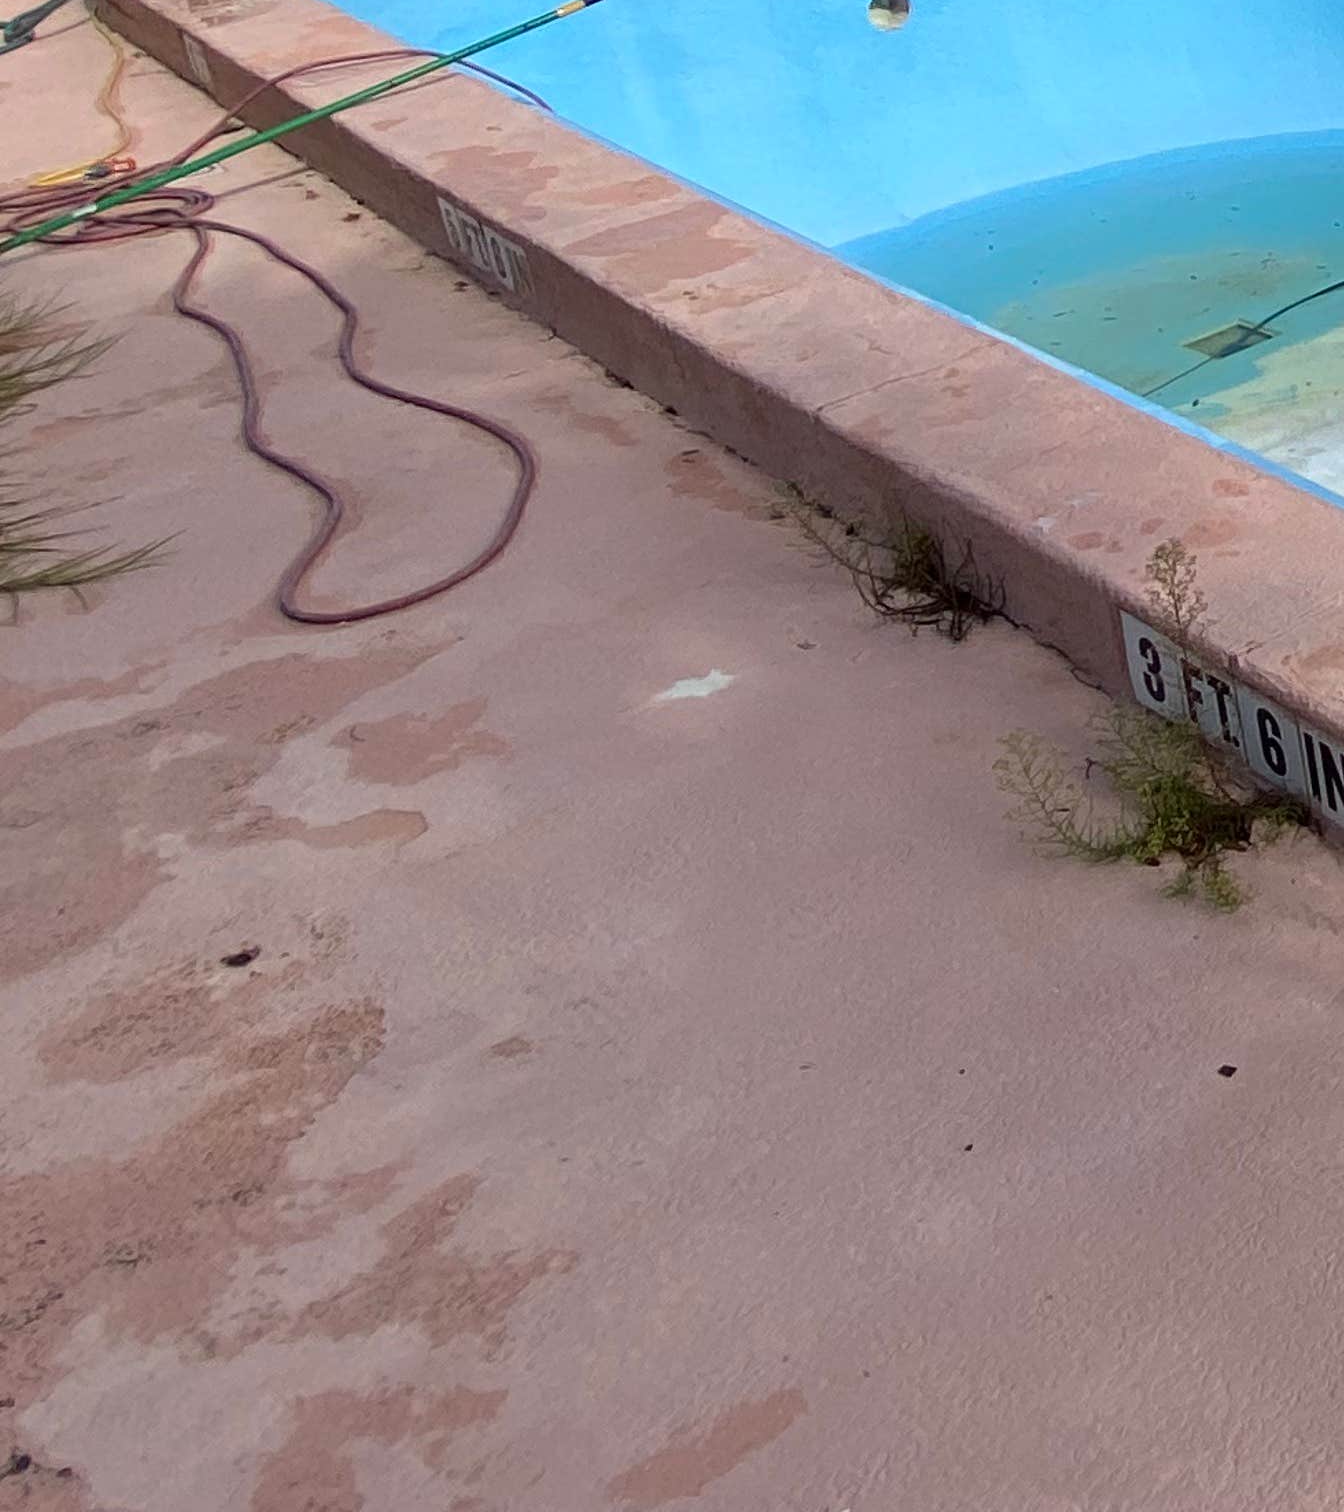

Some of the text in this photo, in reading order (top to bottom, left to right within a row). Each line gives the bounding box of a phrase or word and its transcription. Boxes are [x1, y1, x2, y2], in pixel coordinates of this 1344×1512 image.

[1138, 637, 1166, 703] 3
[1181, 658, 1241, 748] FT.
[1256, 707, 1287, 777] 6
